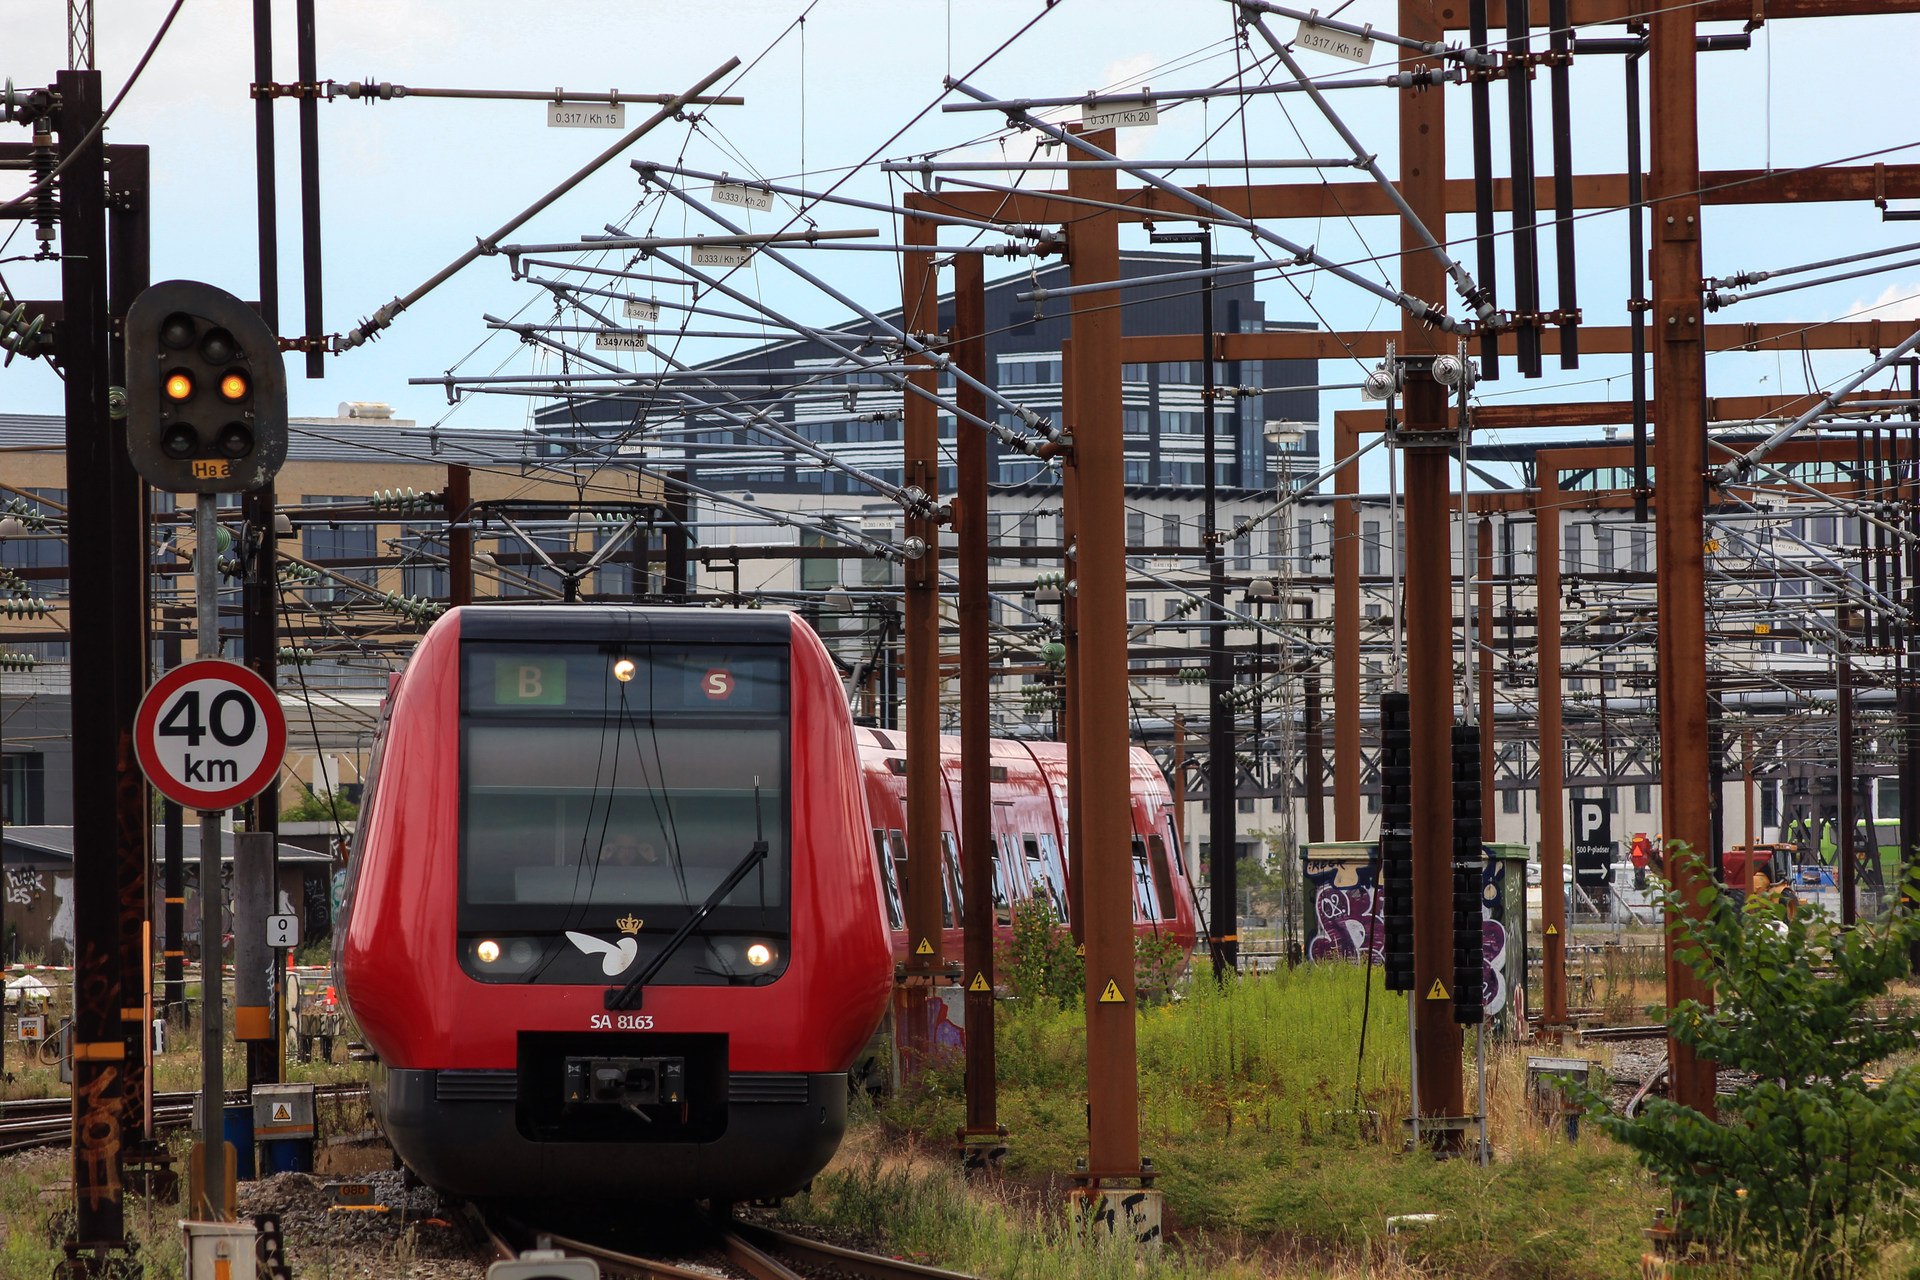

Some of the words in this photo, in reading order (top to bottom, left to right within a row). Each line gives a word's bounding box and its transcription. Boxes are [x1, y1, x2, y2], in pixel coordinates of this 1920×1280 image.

[1304, 34, 1330, 49] 0.317
[1337, 43, 1350, 55] Kh
[1353, 46, 1364, 58] 16
[555, 113, 581, 124] 0.317
[590, 114, 602, 124] Kh
[605, 114, 617, 124] 15
[1090, 113, 1116, 125] 0.317
[1123, 112, 1136, 122] Kh
[1138, 111, 1150, 122] 20
[718, 190, 739, 203] 0.333
[745, 196, 755, 205] Kh
[756, 198, 767, 208] 20
[697, 254, 718, 263] 0.333
[518, 666, 543, 698] B
[708, 673, 728, 694] S
[159, 689, 256, 747] 40
[184, 753, 238, 782] km
[1581, 804, 1603, 841] P
[1576, 846, 1587, 854] 500
[278, 918, 288, 930] 0
[279, 934, 287, 943] 4
[590, 1014, 612, 1029] SA
[617, 1015, 654, 1030] 8163
